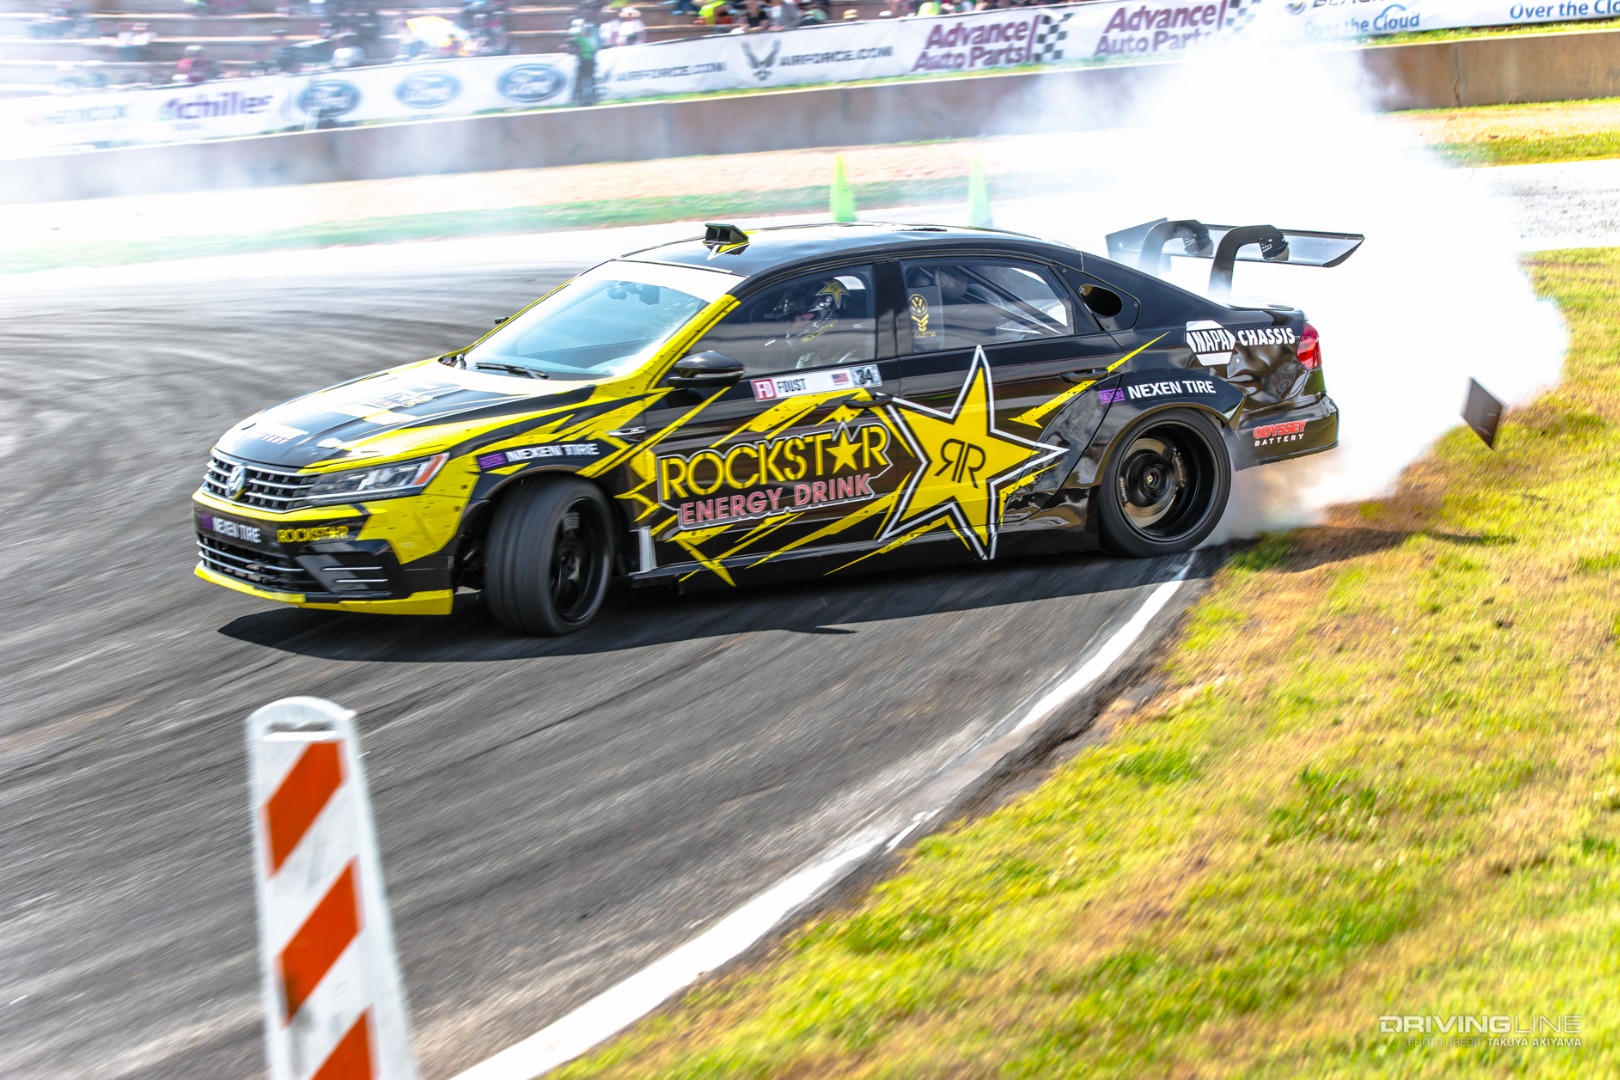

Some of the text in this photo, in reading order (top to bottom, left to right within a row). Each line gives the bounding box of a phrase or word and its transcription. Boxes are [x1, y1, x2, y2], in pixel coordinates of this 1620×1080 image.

[1104, 3, 1218, 34] Advance
[1344, 17, 1370, 32] the
[1373, 8, 1420, 31] Cloud
[1510, 4, 1554, 19] Over
[1559, 1, 1588, 15] the
[924, 20, 1029, 49] Advance
[1093, 36, 1148, 56] Auto
[778, 46, 895, 68] AIRFORCE.COM
[911, 44, 1024, 73] Auto Parts
[1191, 327, 1296, 353] NAPA CHASSIS
[856, 368, 874, 385] 34
[1127, 380, 1217, 399] NEXEN TIRE
[1253, 419, 1307, 439] ODYSSEY
[1254, 433, 1304, 447] BATTERY
[505, 445, 563, 463] NEXEN
[561, 443, 600, 456] TIRE
[680, 473, 871, 525] ENERGY DRINK
[239, 524, 262, 543] TIRE
